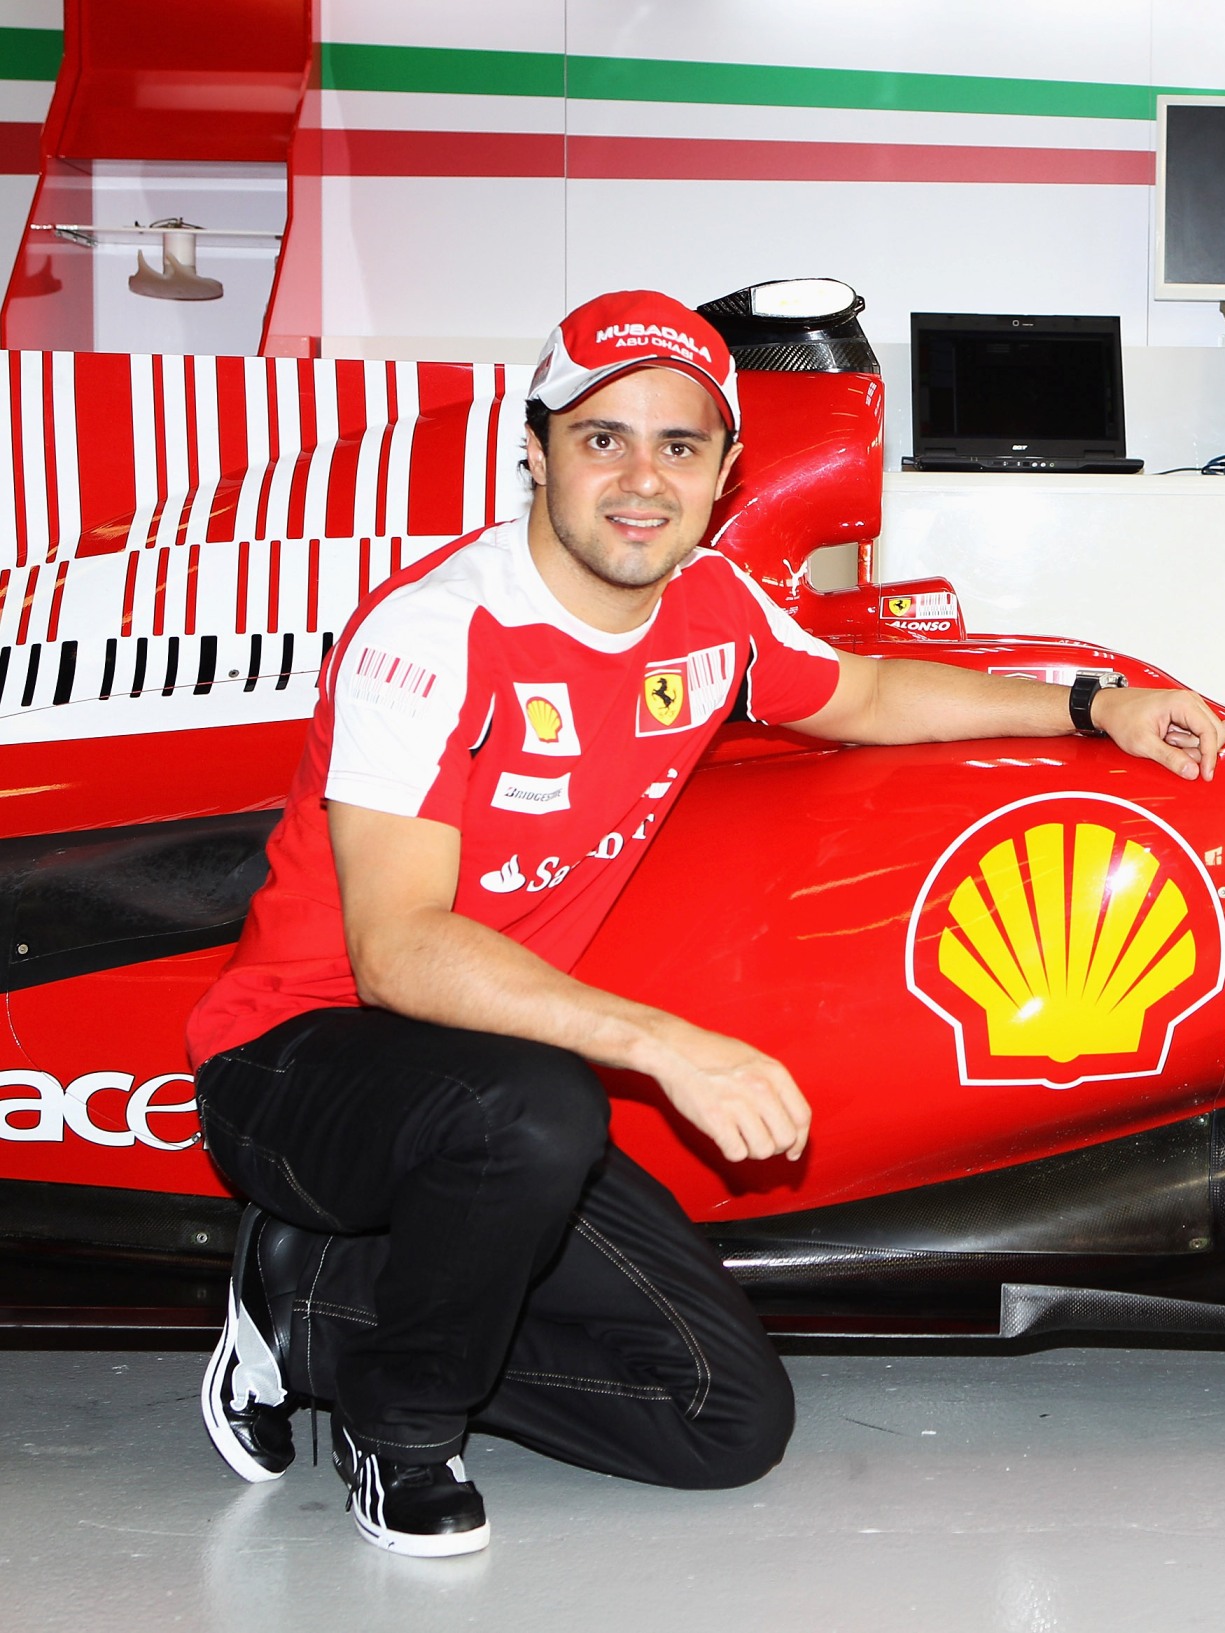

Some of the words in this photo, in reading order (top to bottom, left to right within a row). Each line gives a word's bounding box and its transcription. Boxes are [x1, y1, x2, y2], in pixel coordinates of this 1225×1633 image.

[596, 323, 712, 363] MUBADALA
[615, 337, 649, 348] ABU
[651, 337, 694, 361] DHABI
[890, 620, 951, 632] ALONSO
[0, 1069, 209, 1151] ace
